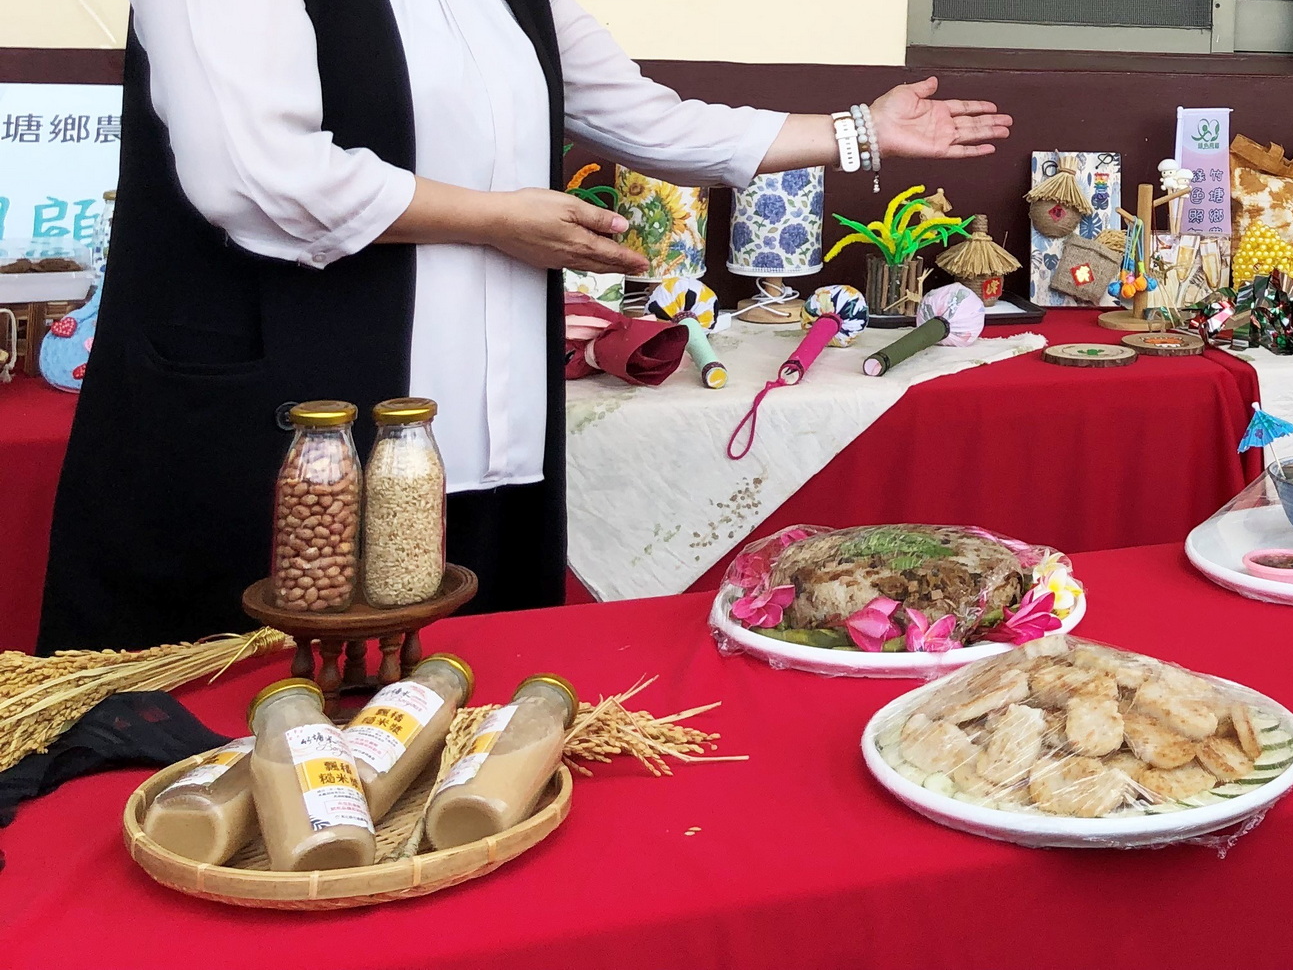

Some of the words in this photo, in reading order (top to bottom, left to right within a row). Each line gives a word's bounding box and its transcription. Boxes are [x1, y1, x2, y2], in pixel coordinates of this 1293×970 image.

[1188, 168, 1206, 232] 綠色照
[1208, 168, 1225, 232] 竹塘鄉
